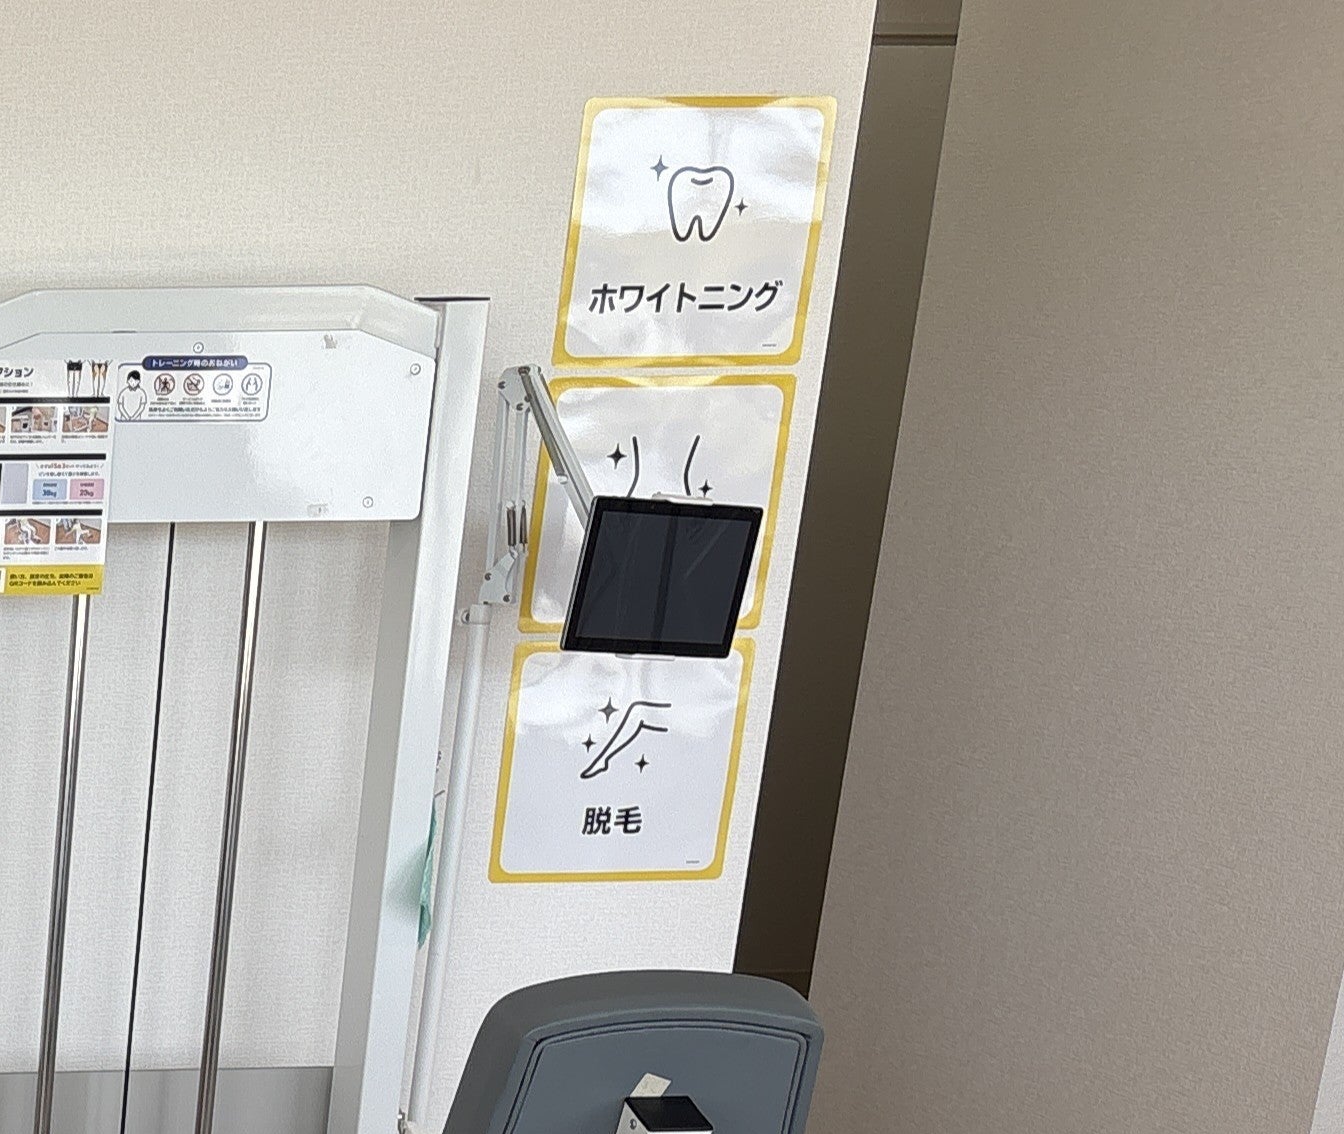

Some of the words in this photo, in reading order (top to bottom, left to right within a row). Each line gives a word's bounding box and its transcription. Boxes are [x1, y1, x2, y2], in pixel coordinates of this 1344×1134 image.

[589, 280, 783, 314] ホワイトニング
[582, 806, 642, 835] 脱毛
